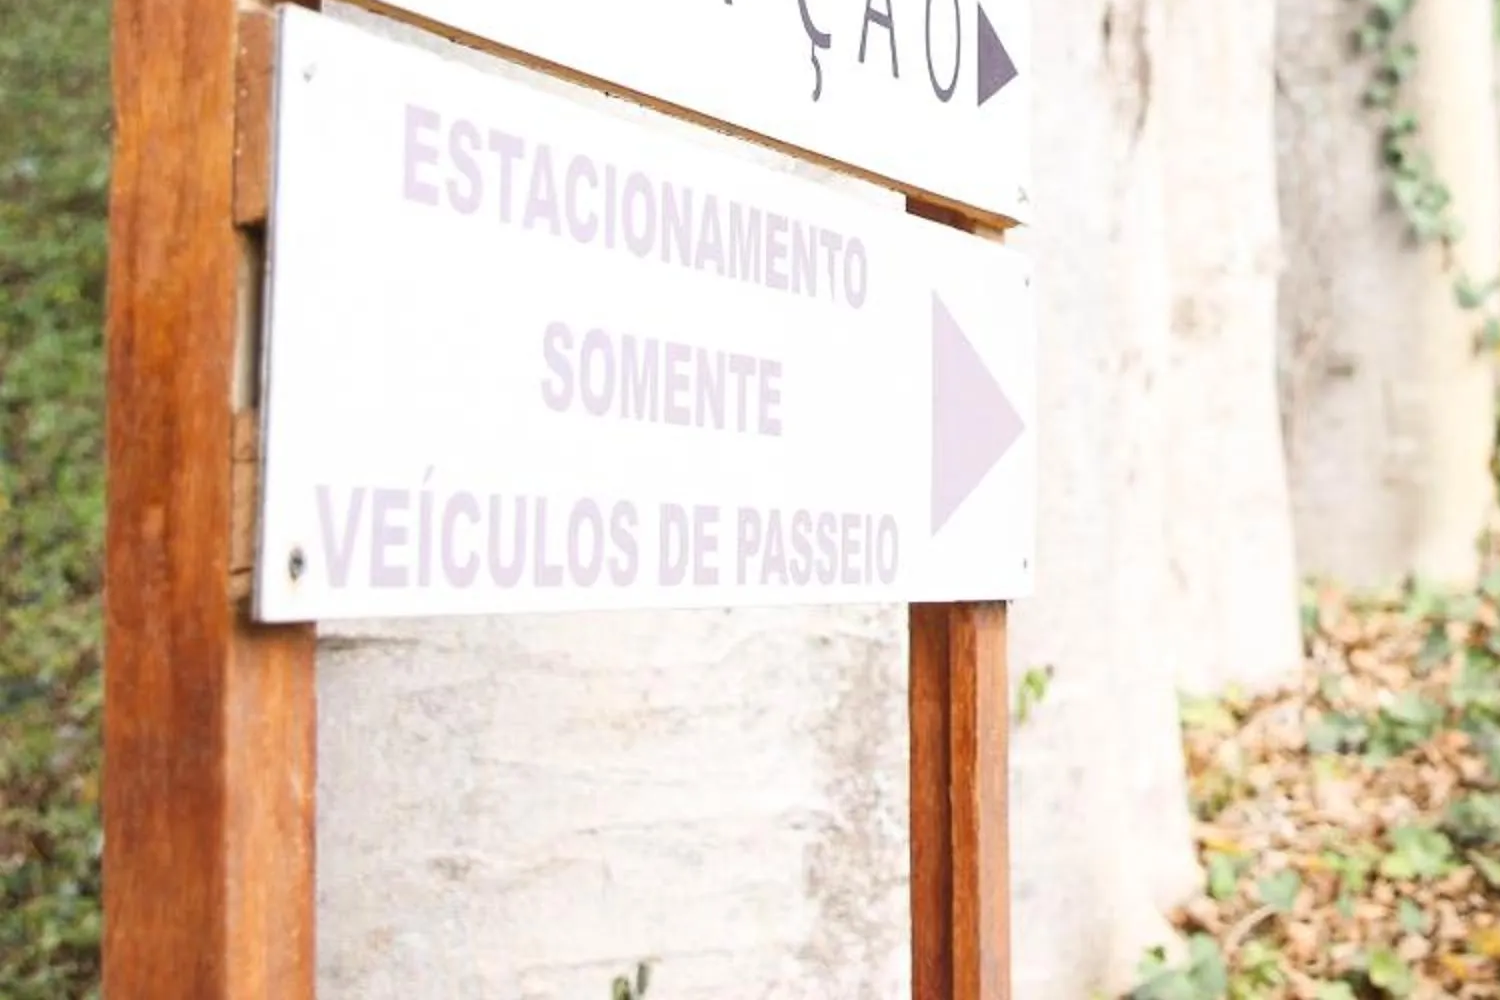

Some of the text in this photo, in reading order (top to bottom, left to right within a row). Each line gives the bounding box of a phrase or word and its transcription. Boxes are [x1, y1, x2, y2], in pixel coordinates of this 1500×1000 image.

[402, 102, 869, 310] ESTACIONAMENTO
[540, 320, 784, 437] SOMENTE
[315, 464, 900, 589] VEÍCULOS DE PASSEIO
